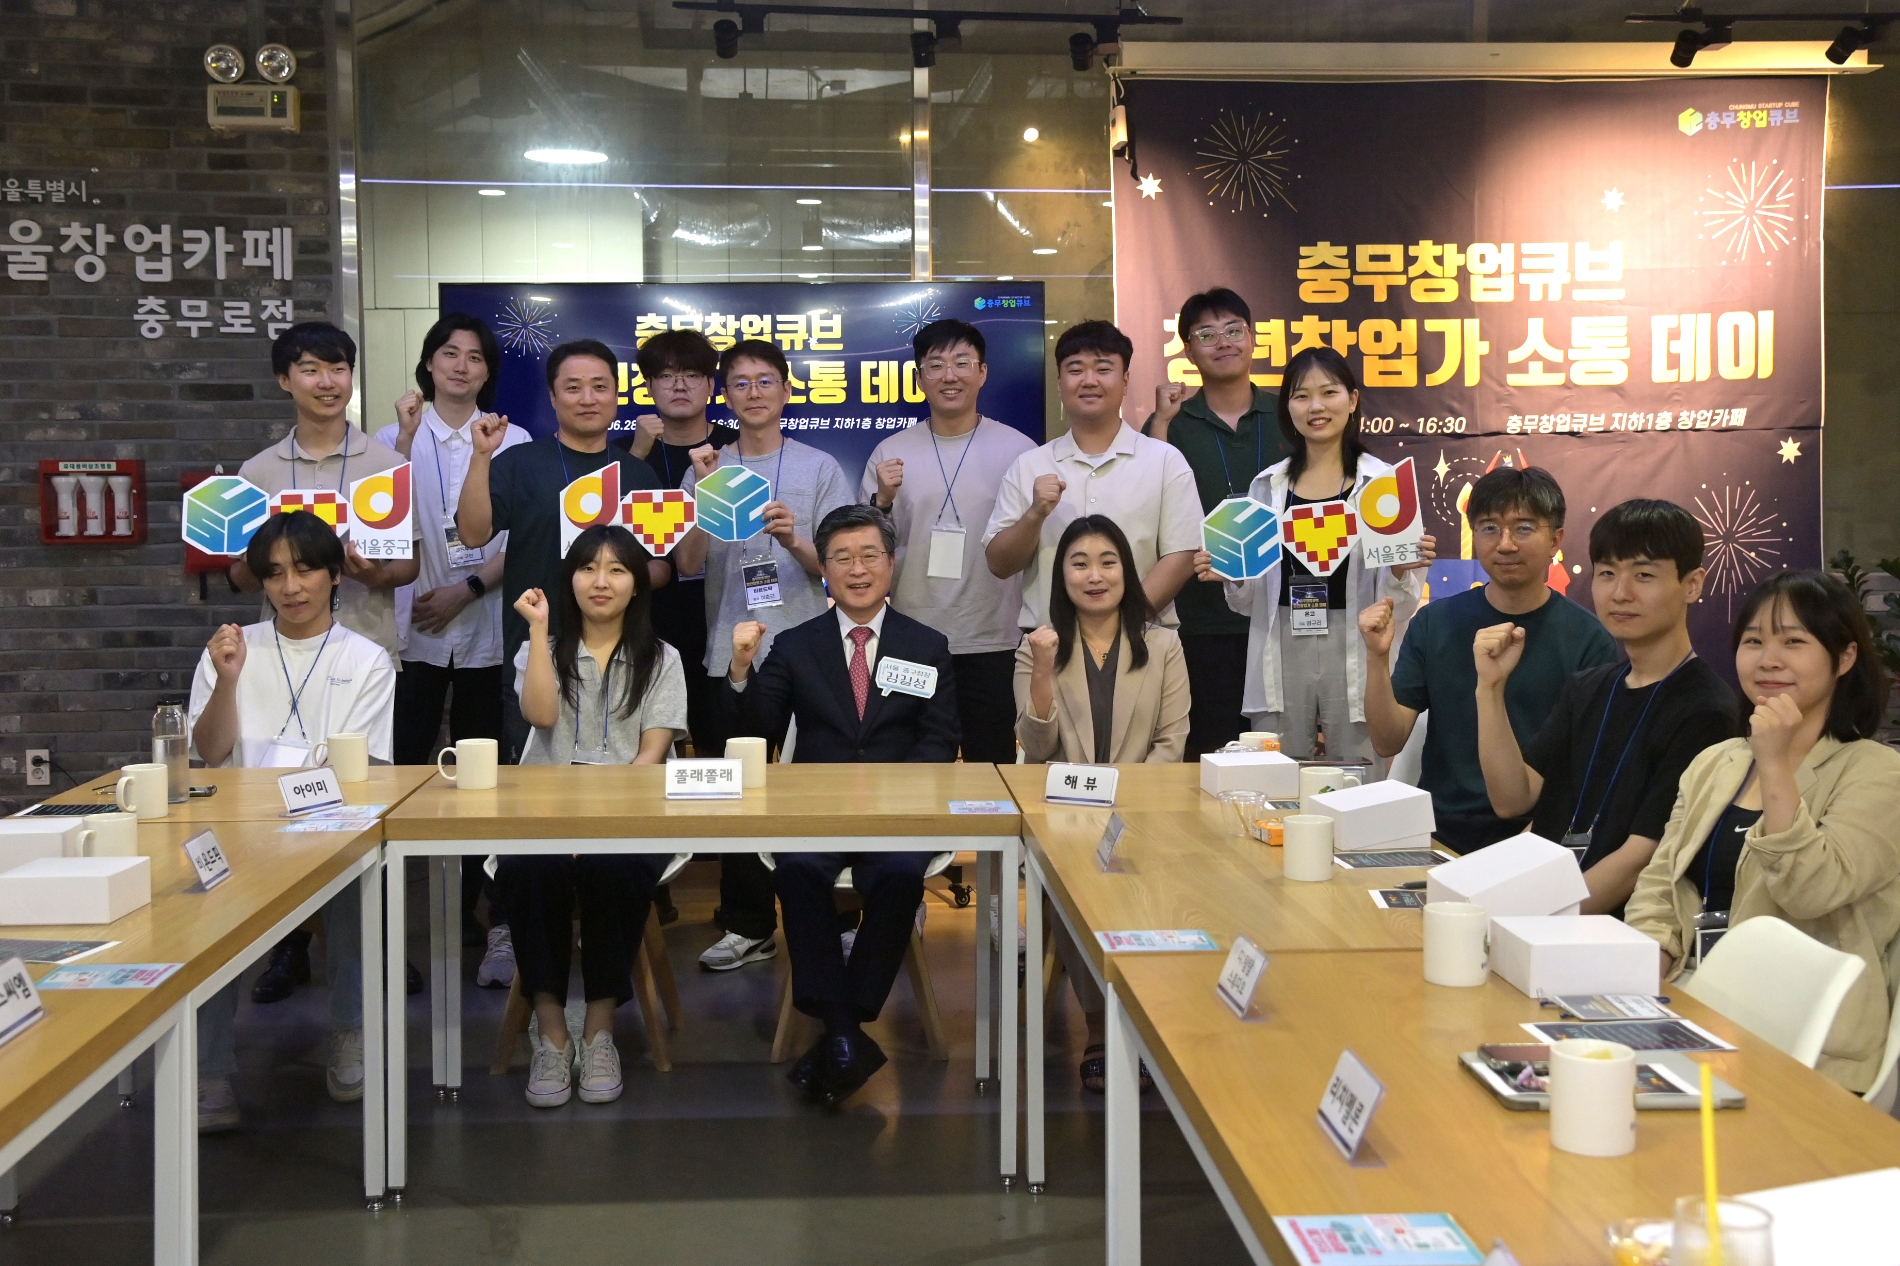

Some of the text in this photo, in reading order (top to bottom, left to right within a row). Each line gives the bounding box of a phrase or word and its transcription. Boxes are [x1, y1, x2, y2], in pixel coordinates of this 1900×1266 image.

[1705, 109, 1799, 130] 충무창업큐브
[0, 178, 87, 203] 울특별시
[0, 219, 293, 283] 울창업카페
[1297, 239, 1625, 304] 충무창업큐브
[986, 299, 1031, 309] 충무창업큐브
[133, 296, 294, 341] 충무로점
[1506, 315, 1631, 387] 소통
[1651, 309, 1775, 384] 데이
[779, 416, 918, 430] 무창업큐브 지하1층 창업카페
[1360, 417, 1394, 434] :00
[1417, 416, 1467, 434] 16:30
[1506, 408, 1748, 434] 충무창업큐브 지하1층 창업카페
[355, 539, 411, 556] 서울중구
[885, 663, 932, 679] 서울 중구청장
[886, 671, 927, 690] 김길성
[674, 768, 733, 785] 쫄래쫄래
[1064, 775, 1098, 791] 해 뷰
[293, 779, 329, 799] 아이미
